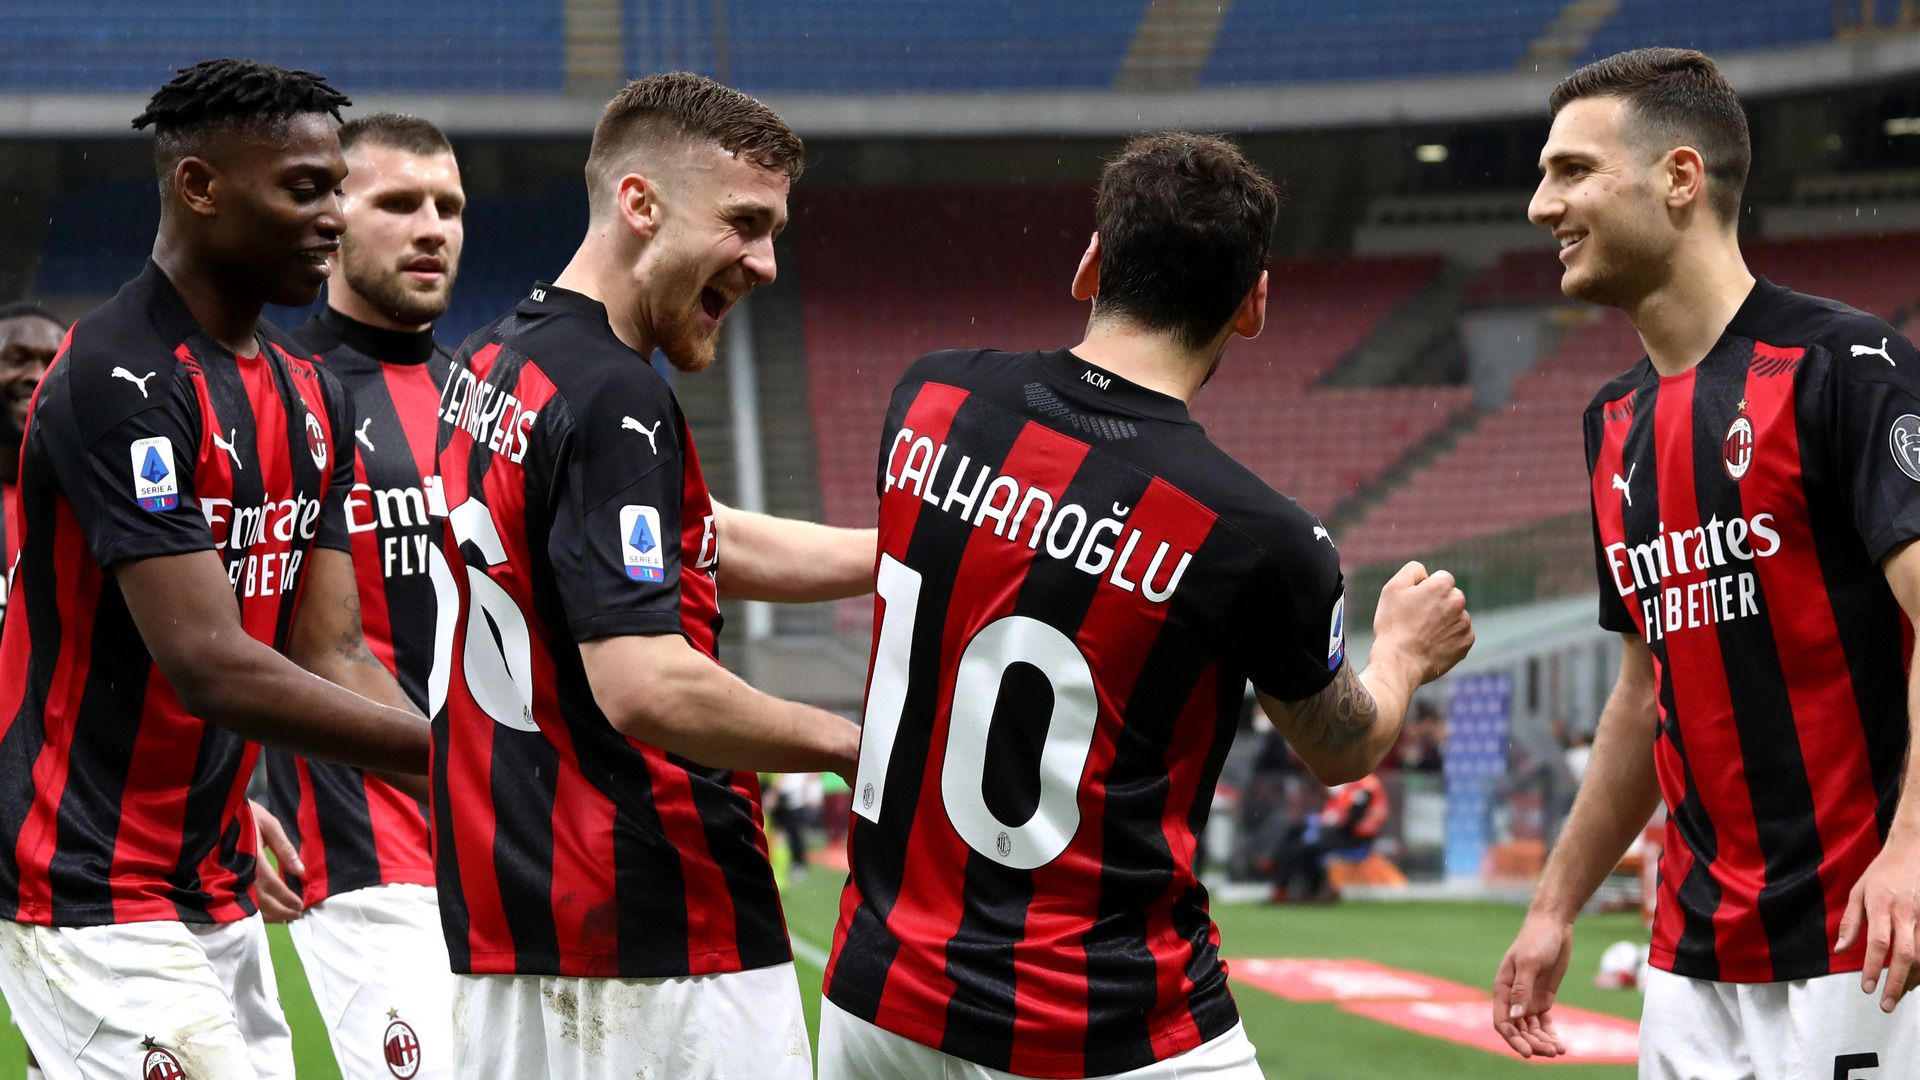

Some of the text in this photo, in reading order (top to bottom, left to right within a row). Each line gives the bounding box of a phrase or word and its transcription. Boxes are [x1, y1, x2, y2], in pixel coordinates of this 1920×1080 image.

[1080, 369, 1111, 390] ACM
[141, 485, 165, 495] SERIE
[884, 428, 1193, 603] ÇALHANOĞLU
[384, 534, 428, 578] FLY
[1605, 513, 1781, 597] Emirates
[1665, 572, 1760, 632] BETTER
[851, 552, 1099, 870] 10
